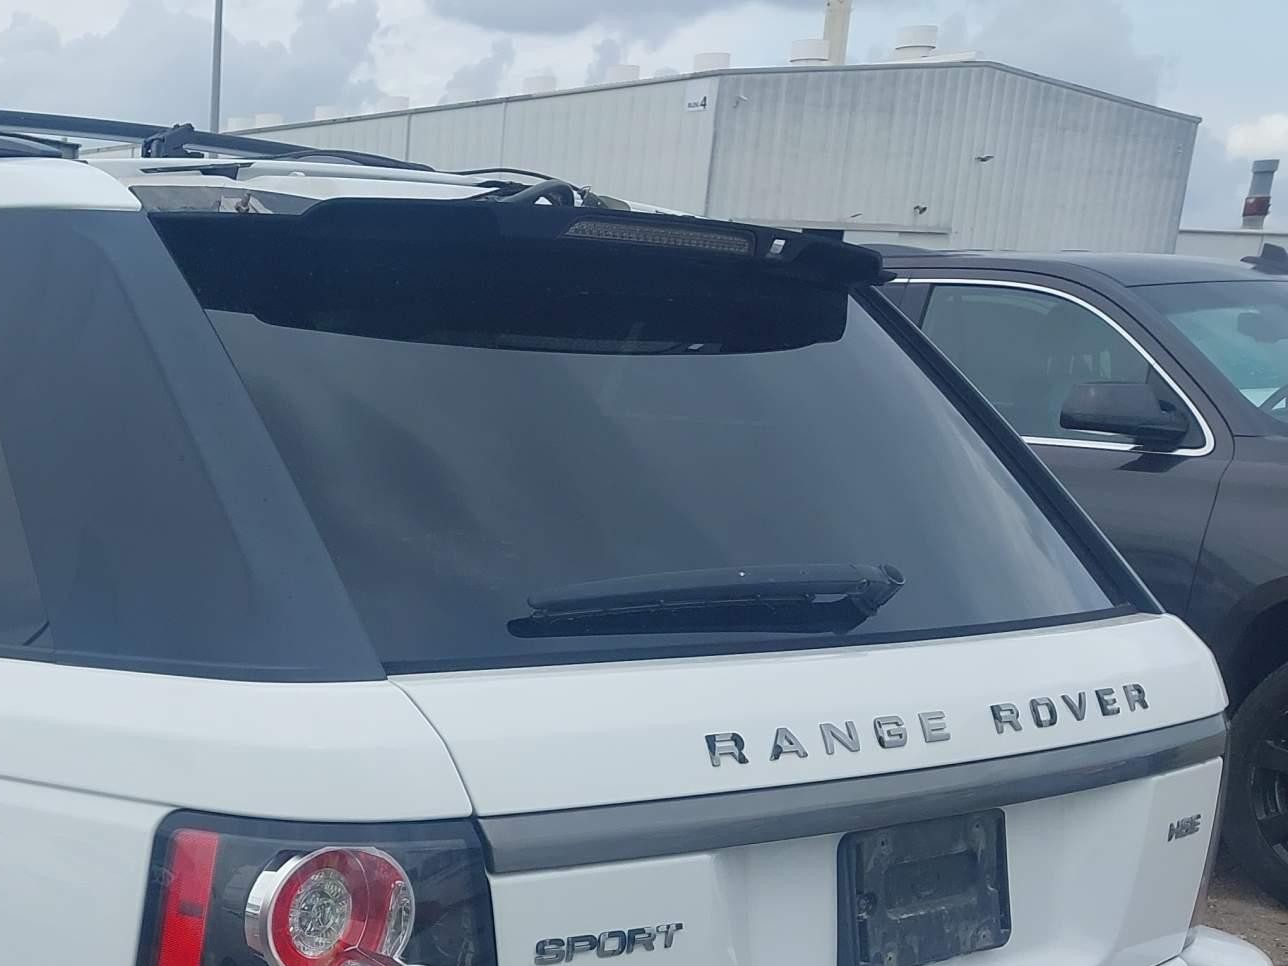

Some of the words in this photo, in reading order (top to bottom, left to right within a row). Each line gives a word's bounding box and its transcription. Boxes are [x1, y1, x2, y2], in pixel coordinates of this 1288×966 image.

[704, 709, 952, 768] RANGE
[989, 682, 1150, 735] ROVER
[534, 922, 684, 966] SPORT
